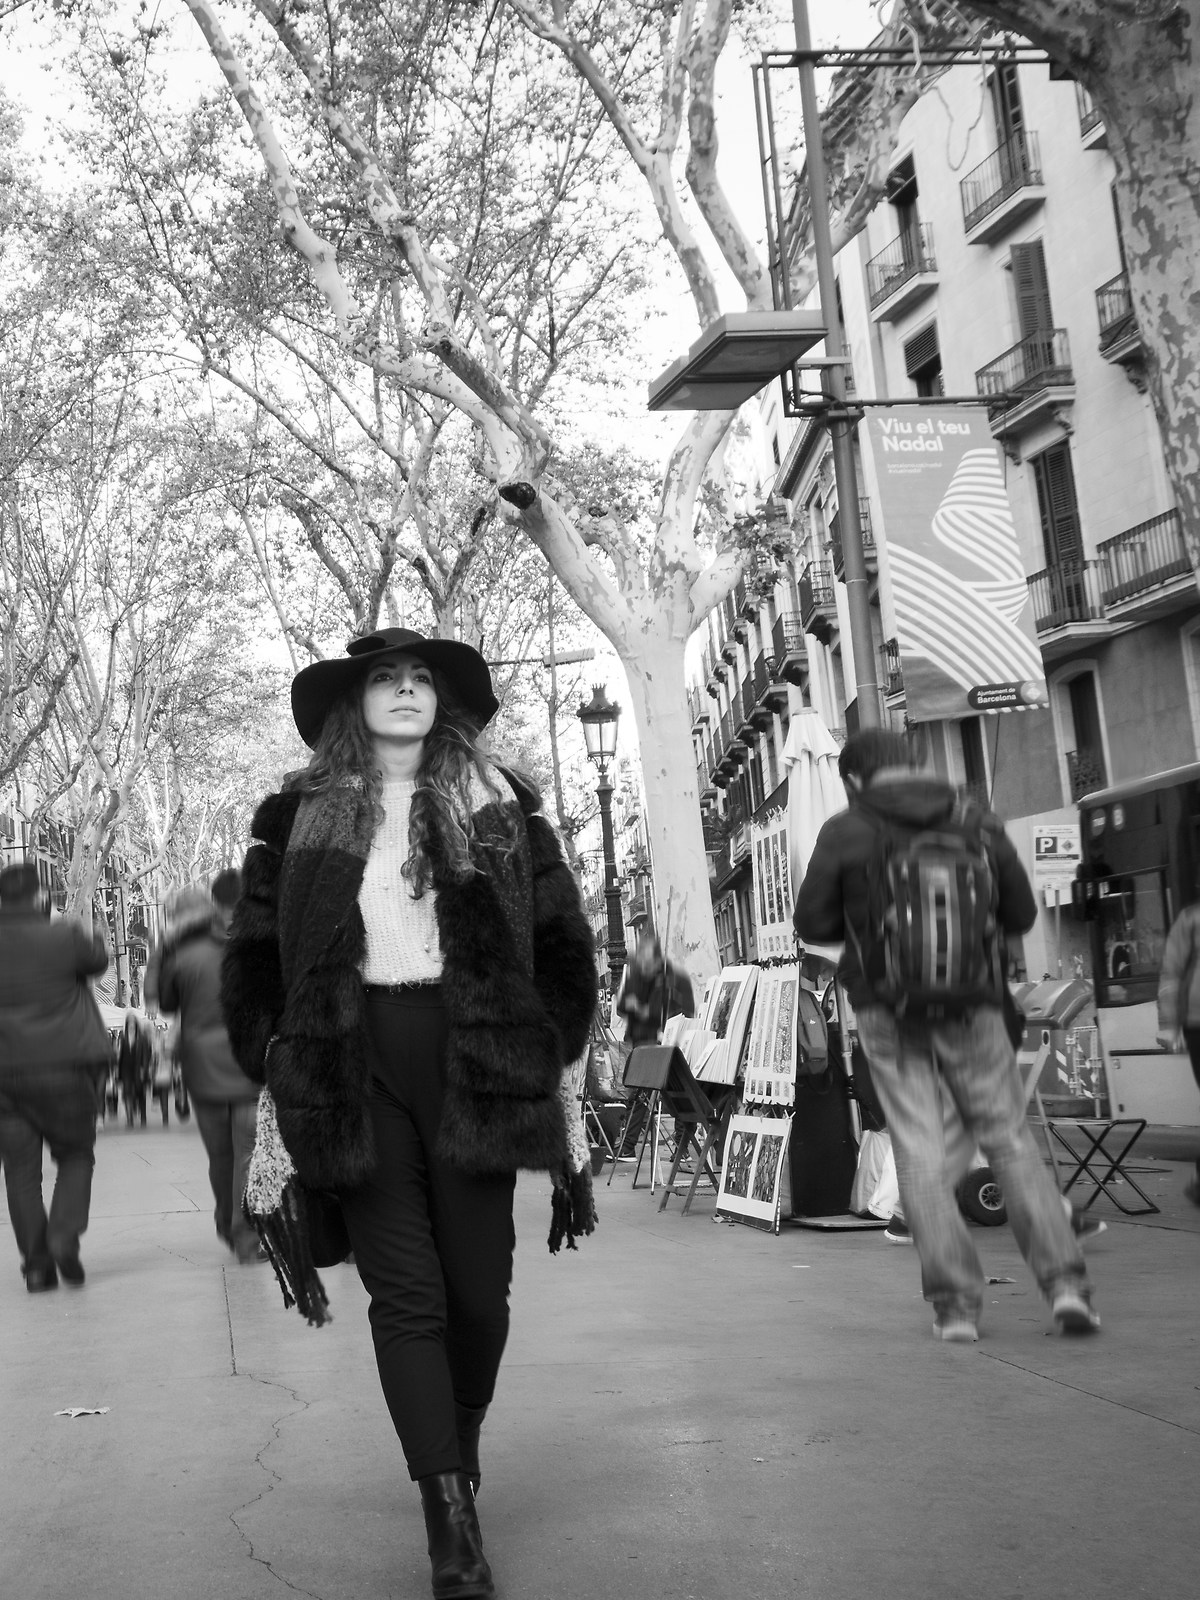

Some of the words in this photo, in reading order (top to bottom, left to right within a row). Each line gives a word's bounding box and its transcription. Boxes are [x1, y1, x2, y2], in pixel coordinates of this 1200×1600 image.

[878, 418, 912, 433] Viu
[916, 418, 934, 433] el
[937, 420, 970, 434] teu
[882, 435, 943, 451] Nadal
[977, 689, 1008, 697] Ajuntament
[977, 694, 1017, 704] Barcelona
[1040, 837, 1053, 853] P
